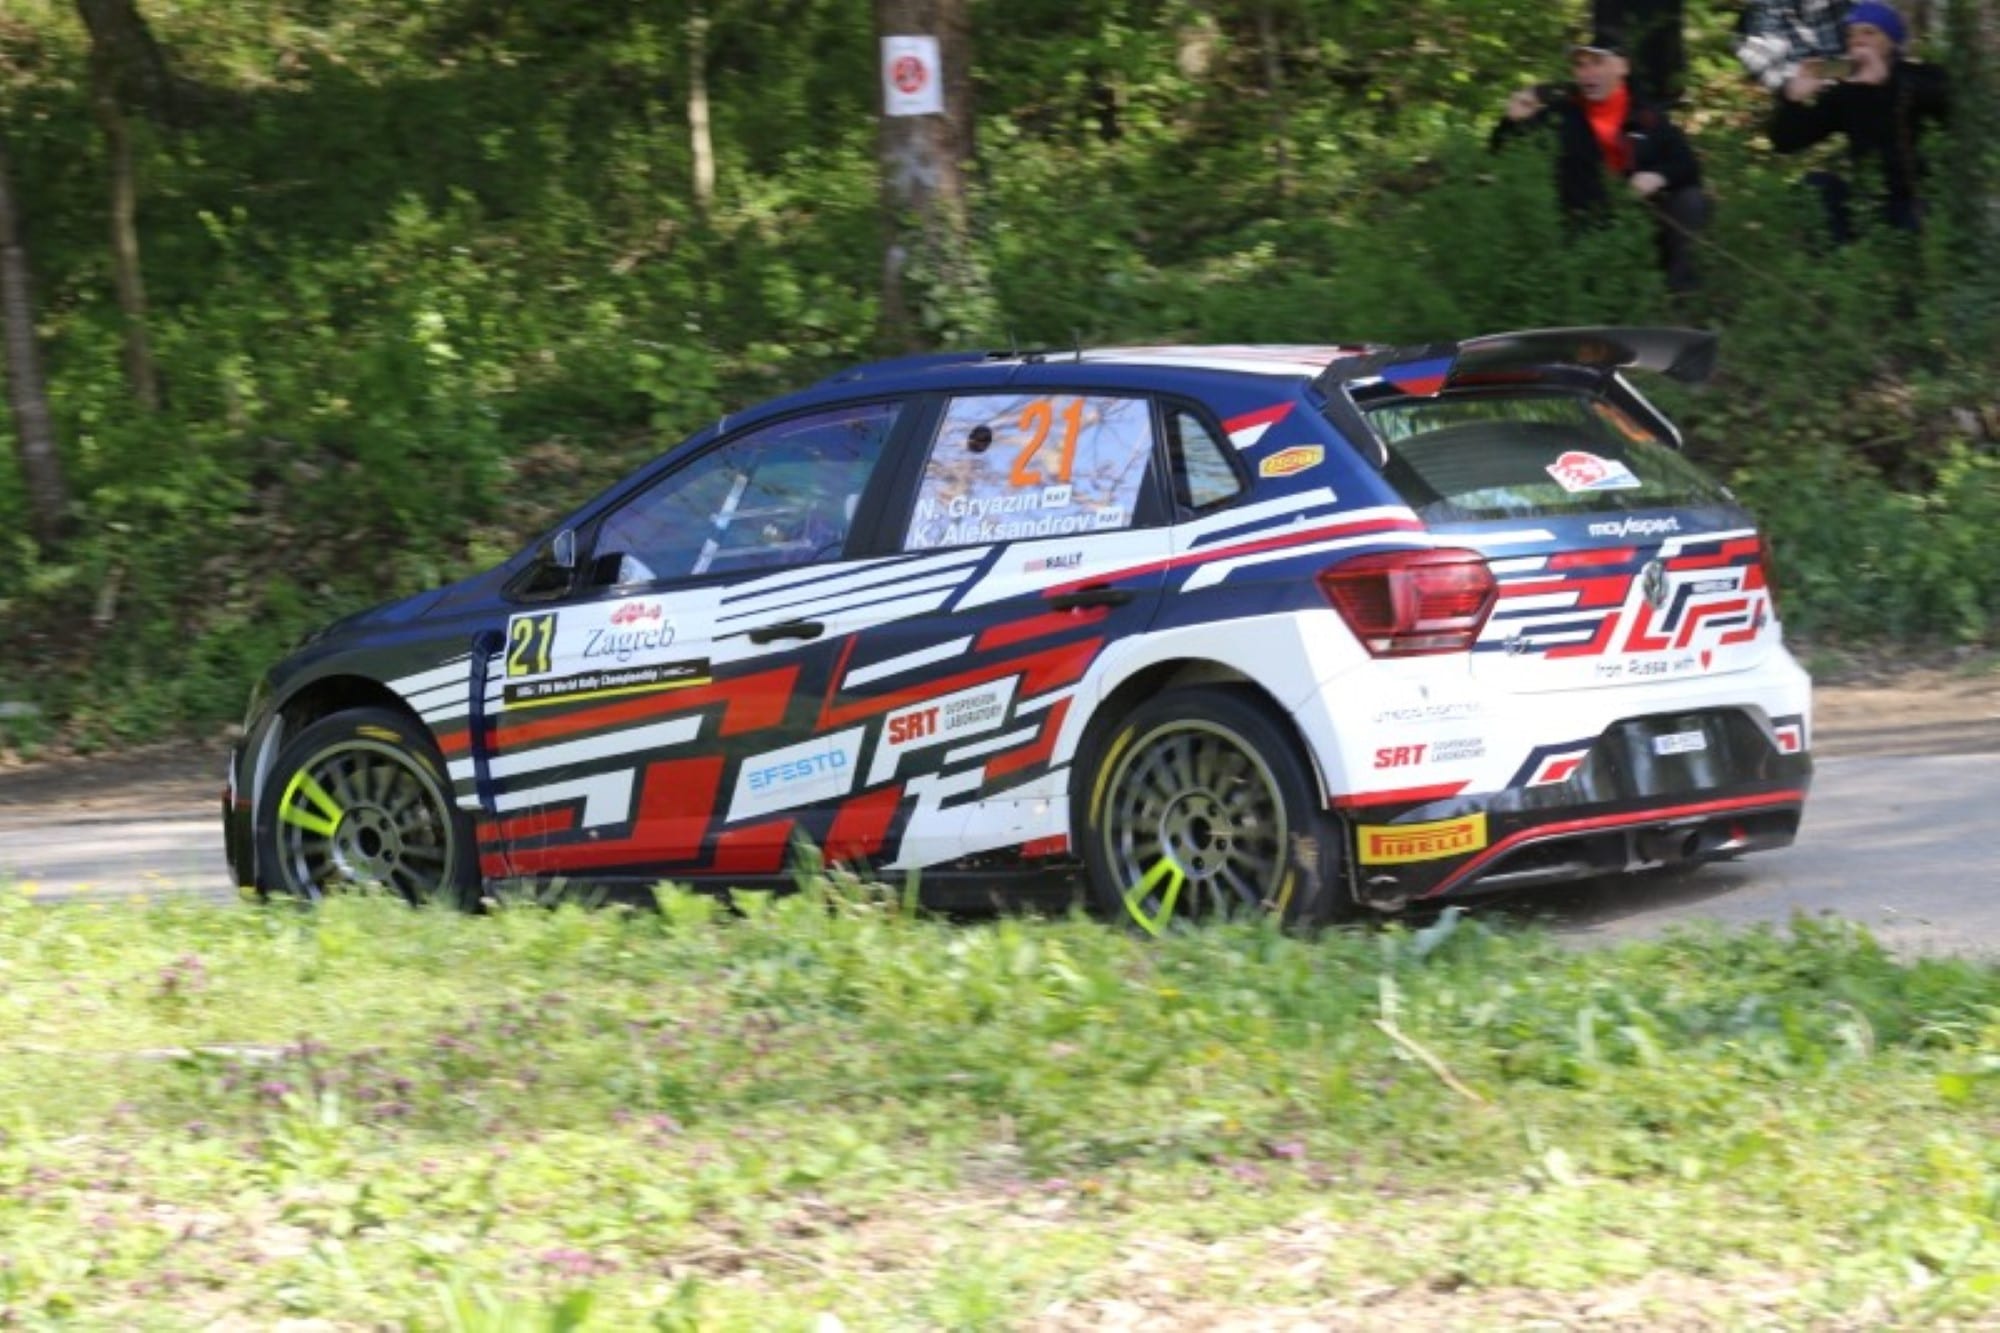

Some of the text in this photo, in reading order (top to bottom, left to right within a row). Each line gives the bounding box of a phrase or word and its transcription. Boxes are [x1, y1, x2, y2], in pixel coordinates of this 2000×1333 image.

[1009, 397, 1086, 487] 21
[919, 499, 940, 520] N.
[951, 494, 1038, 520] Gryazin
[942, 513, 1091, 544] Aleksandrov
[508, 614, 553, 676] 21
[583, 619, 675, 662] Zagreb
[889, 706, 940, 746] SRT
[945, 703, 1002, 730] LABORATORY
[748, 749, 847, 791] EFESTO
[1374, 743, 1428, 769] SRT
[1370, 823, 1475, 858] PIRELLI
